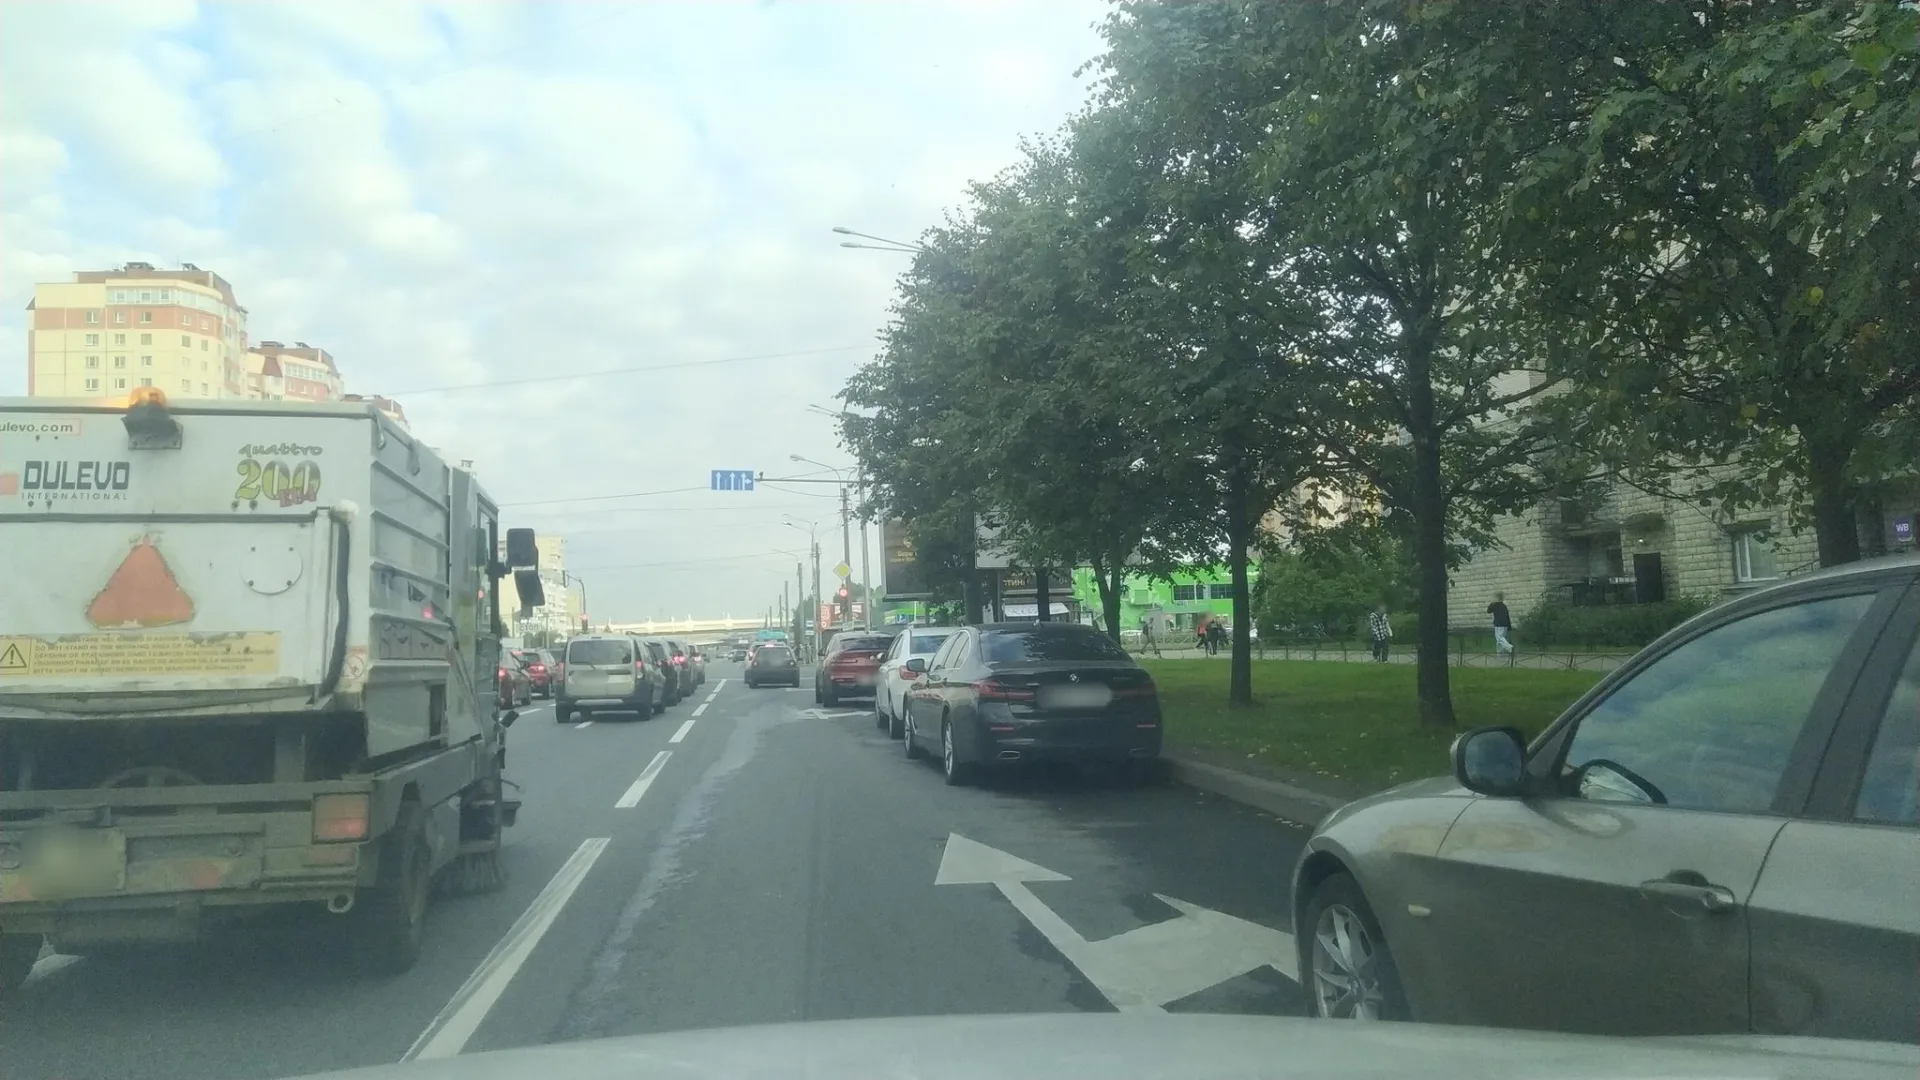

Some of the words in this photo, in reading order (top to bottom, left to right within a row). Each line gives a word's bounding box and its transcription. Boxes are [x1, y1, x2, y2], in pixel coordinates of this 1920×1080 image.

[238, 443, 323, 458] quattro
[23, 460, 131, 490] DULEVO
[235, 459, 321, 500] 200
[21, 492, 129, 501] INTERNATIONAL
[1895, 523, 1909, 532] WB
